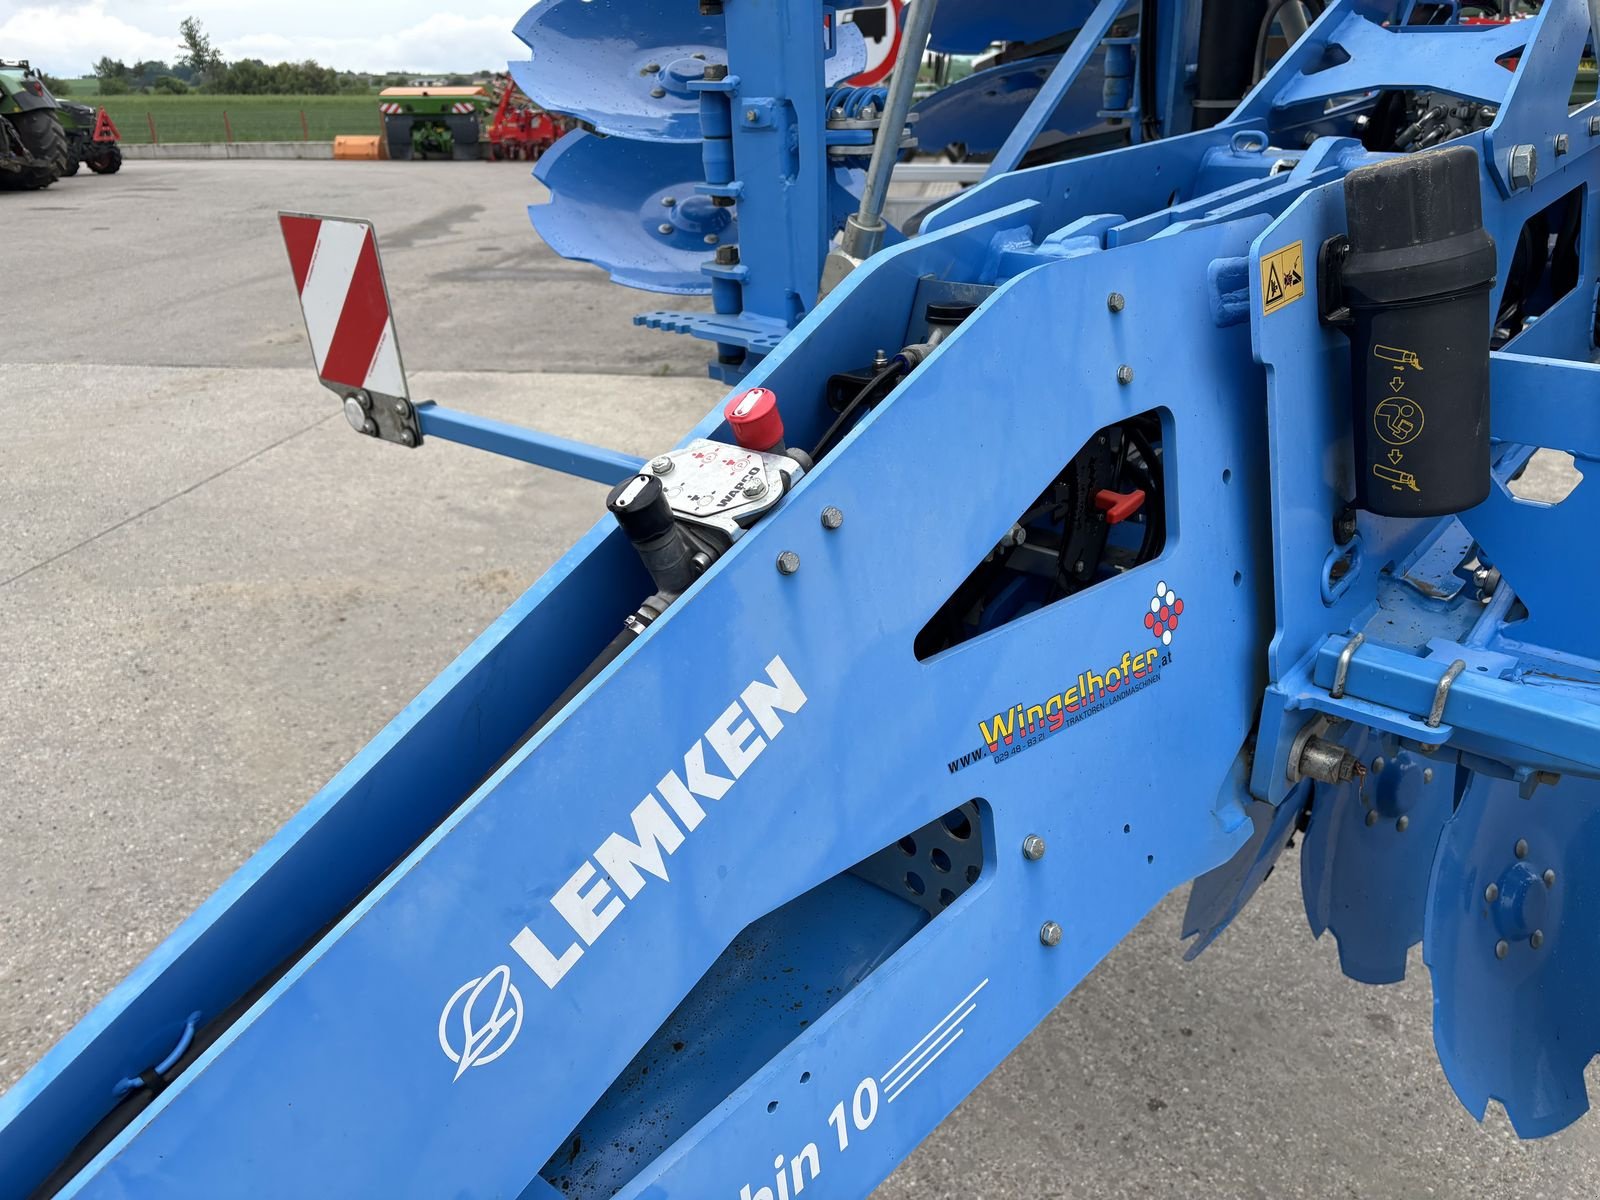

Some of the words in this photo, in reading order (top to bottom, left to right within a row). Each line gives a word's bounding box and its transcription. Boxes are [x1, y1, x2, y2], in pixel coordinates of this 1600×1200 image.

[1065, 702, 1105, 728] TRAKTOREN
[1109, 673, 1161, 706] LANDMASCHINEN
[994, 751, 1009, 765] 029
[1011, 744, 1021, 755] 48
[1027, 736, 1037, 747] 83
[509, 654, 808, 990] LEMKEN
[739, 1142, 821, 1200] in
[828, 1077, 879, 1152] 10
